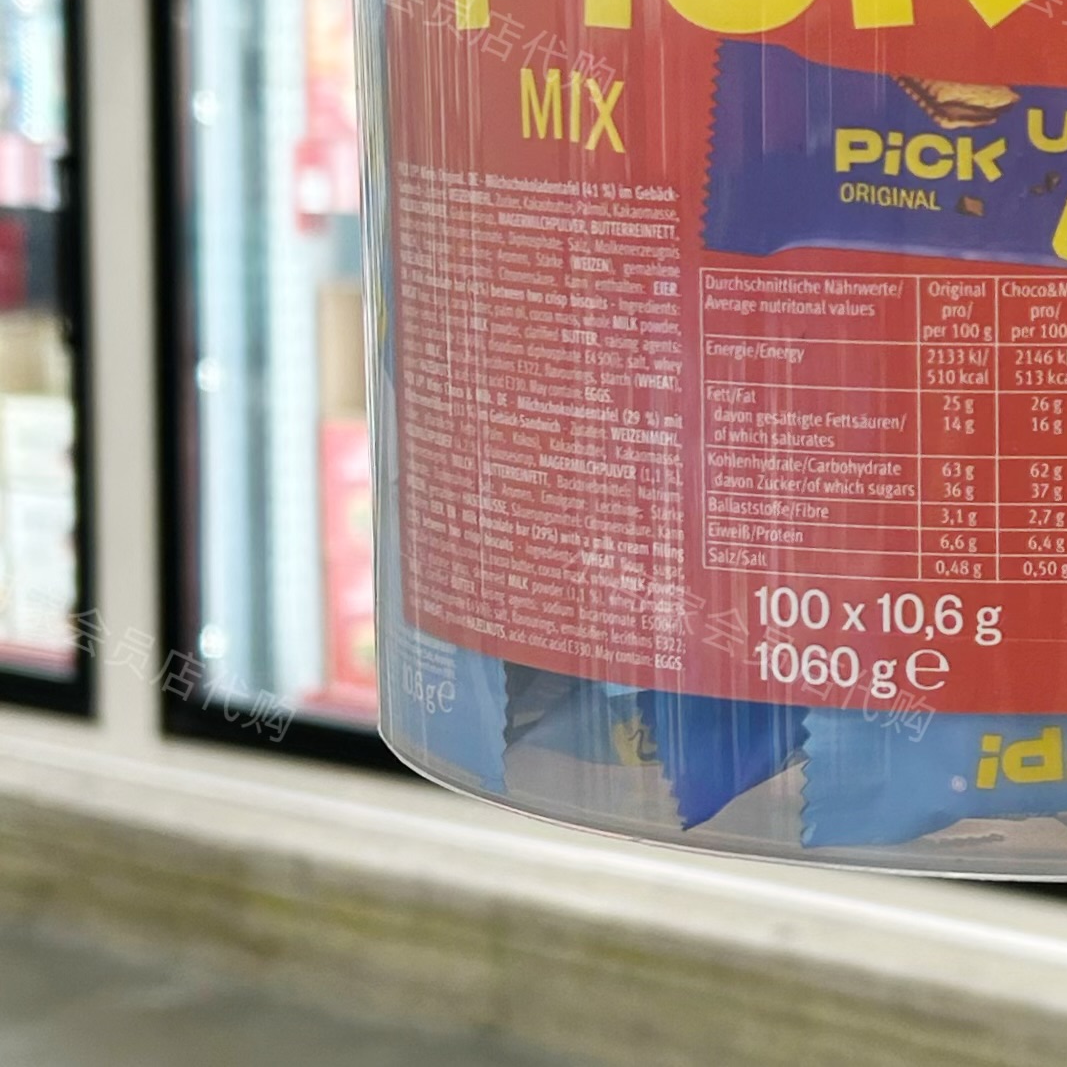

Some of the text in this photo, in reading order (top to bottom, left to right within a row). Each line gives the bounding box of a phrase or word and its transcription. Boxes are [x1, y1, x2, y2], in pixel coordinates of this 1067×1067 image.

[520, 67, 626, 154] MIX
[839, 181, 942, 212] ORIGINAL
[928, 281, 985, 300] Original
[705, 295, 757, 315] Average
[830, 300, 875, 316] values
[923, 324, 992, 341] per 100 g
[1011, 326, 1035, 342] per
[1041, 324, 1067, 338] 100
[927, 349, 964, 364] 2133
[1015, 350, 1053, 365] 2146
[927, 369, 989, 385] 510 kcal
[1015, 370, 1043, 385] 513
[707, 386, 756, 404] Fett/Fat
[943, 396, 974, 413] 25 g
[1031, 397, 1063, 414] 26 g
[944, 416, 974, 435] 14 g
[1032, 417, 1063, 435] 16 g
[714, 428, 727, 441] of
[730, 430, 768, 444] which
[942, 462, 974, 480] 63 g
[1030, 462, 1063, 481] 62 g
[714, 472, 753, 488] davon
[824, 481, 864, 495] which
[868, 482, 915, 498] sugars
[943, 482, 974, 501] 36 g
[1032, 483, 1063, 501] 37 g
[968, 511, 977, 526] g
[1056, 512, 1065, 527] g
[968, 537, 977, 552] g
[1056, 537, 1065, 553] g
[708, 548, 767, 566] Salz/Salt
[936, 560, 982, 579] 0,48 g
[1023, 561, 1057, 577] 0,50
[754, 586, 830, 630] 100
[877, 593, 964, 641] 10,6
[975, 605, 1002, 646] g
[754, 642, 859, 688] 1060
[871, 658, 897, 699] g
